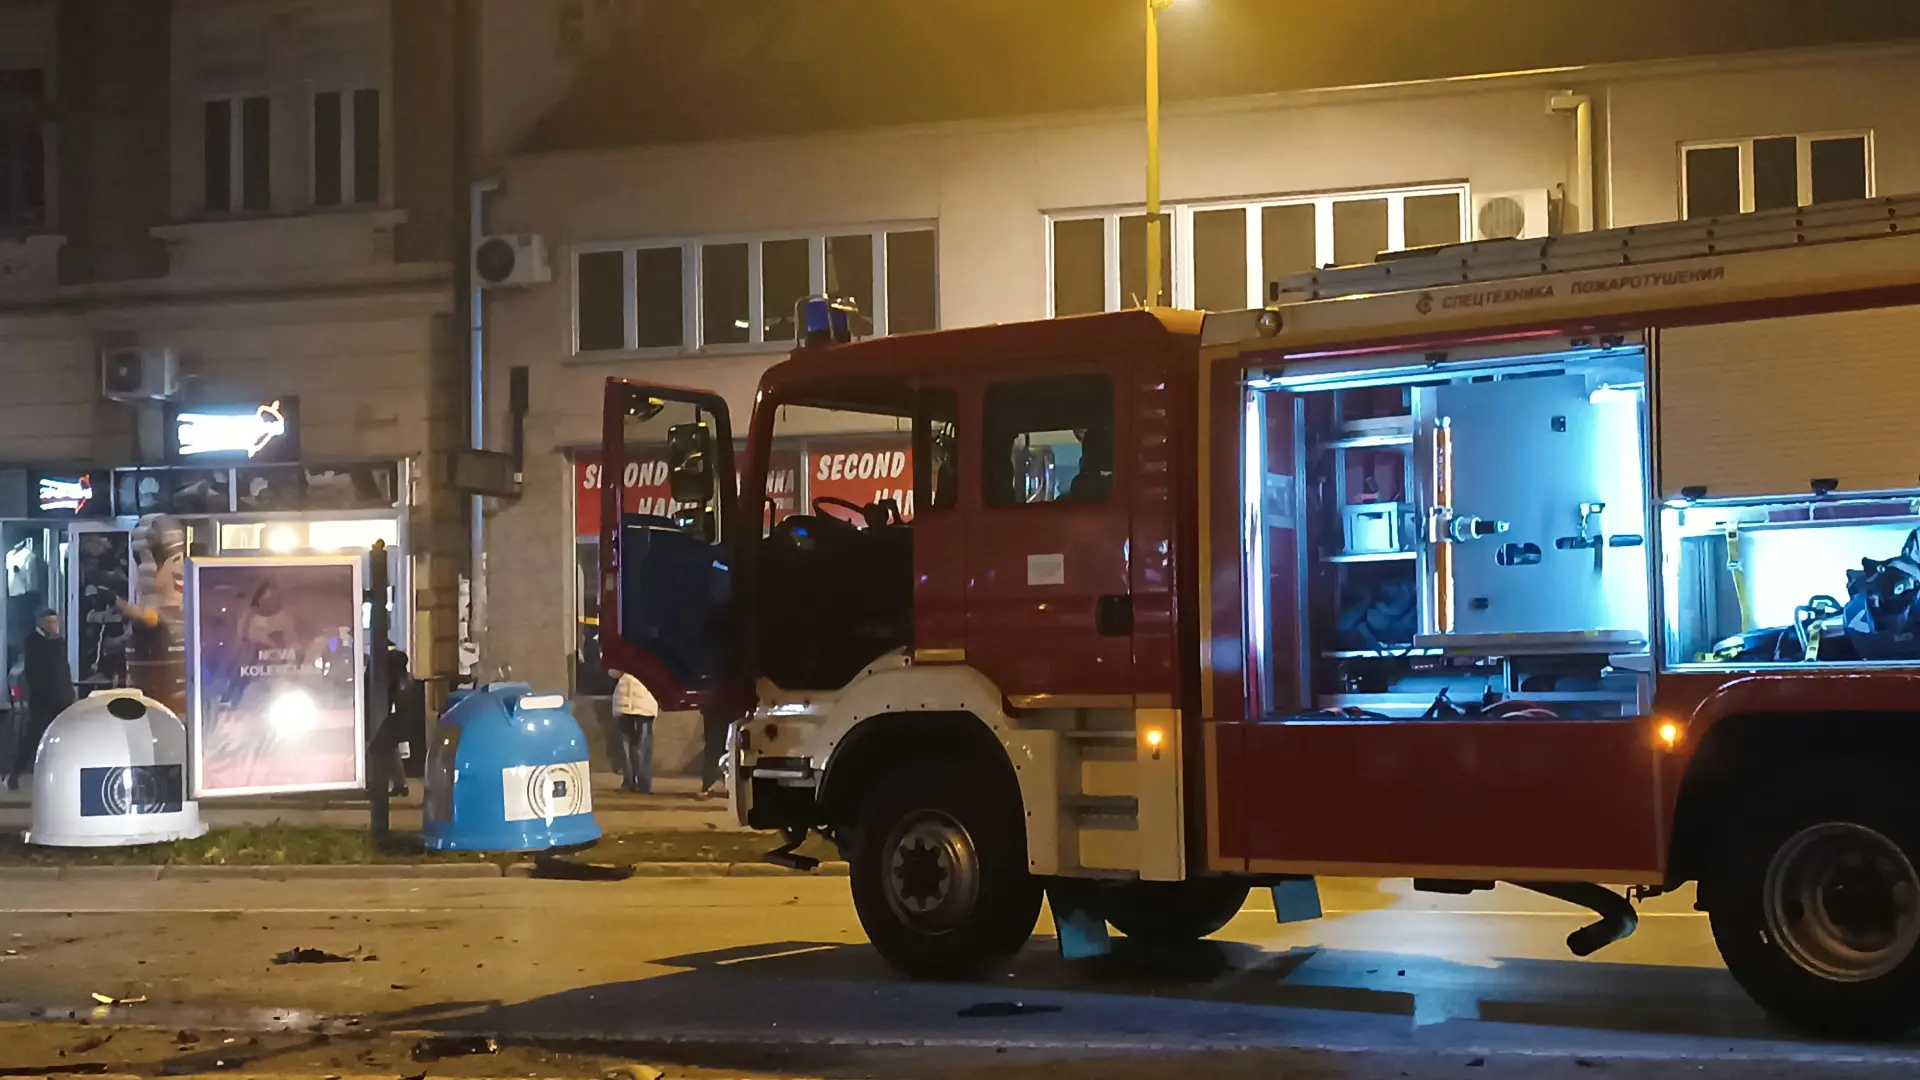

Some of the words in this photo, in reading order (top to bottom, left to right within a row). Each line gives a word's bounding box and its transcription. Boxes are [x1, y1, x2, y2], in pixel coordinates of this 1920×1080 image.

[1571, 266, 1725, 295] ПОЖАРОТУШЕНИЯ
[583, 460, 669, 489] SOND
[817, 451, 906, 481] SECOND
[258, 649, 297, 661] NOVA
